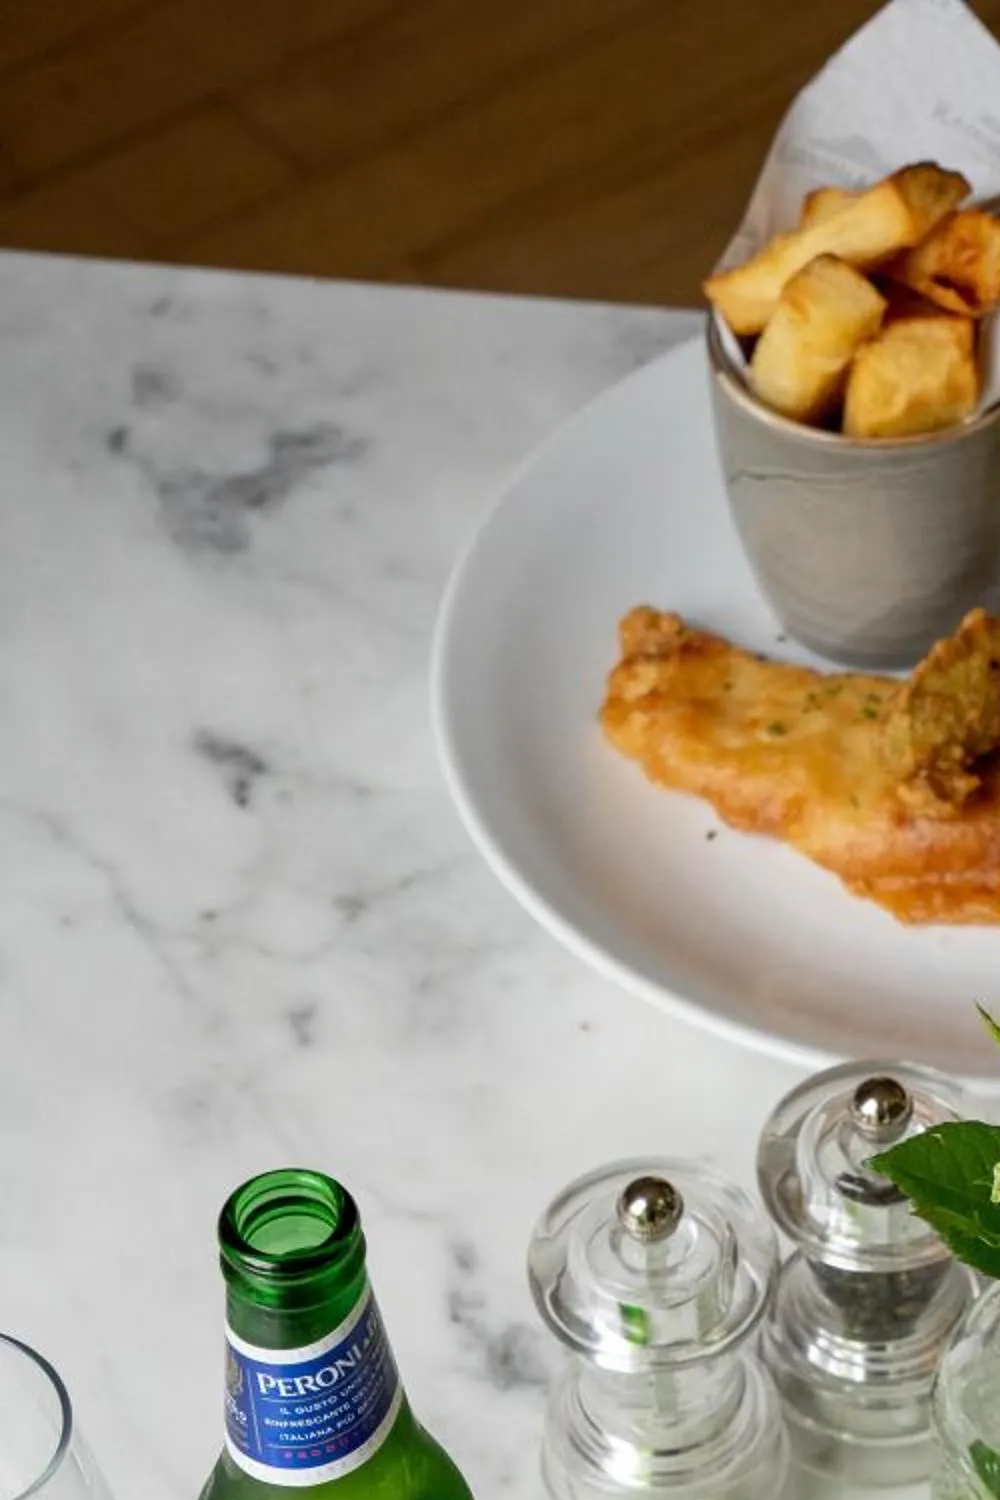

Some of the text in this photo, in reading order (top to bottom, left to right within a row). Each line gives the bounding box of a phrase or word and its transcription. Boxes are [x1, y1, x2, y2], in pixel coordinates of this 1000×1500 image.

[256, 1345, 363, 1397] PERONI
[294, 1396, 338, 1415] GUSTO
[279, 1427, 335, 1441] ITALIANA
